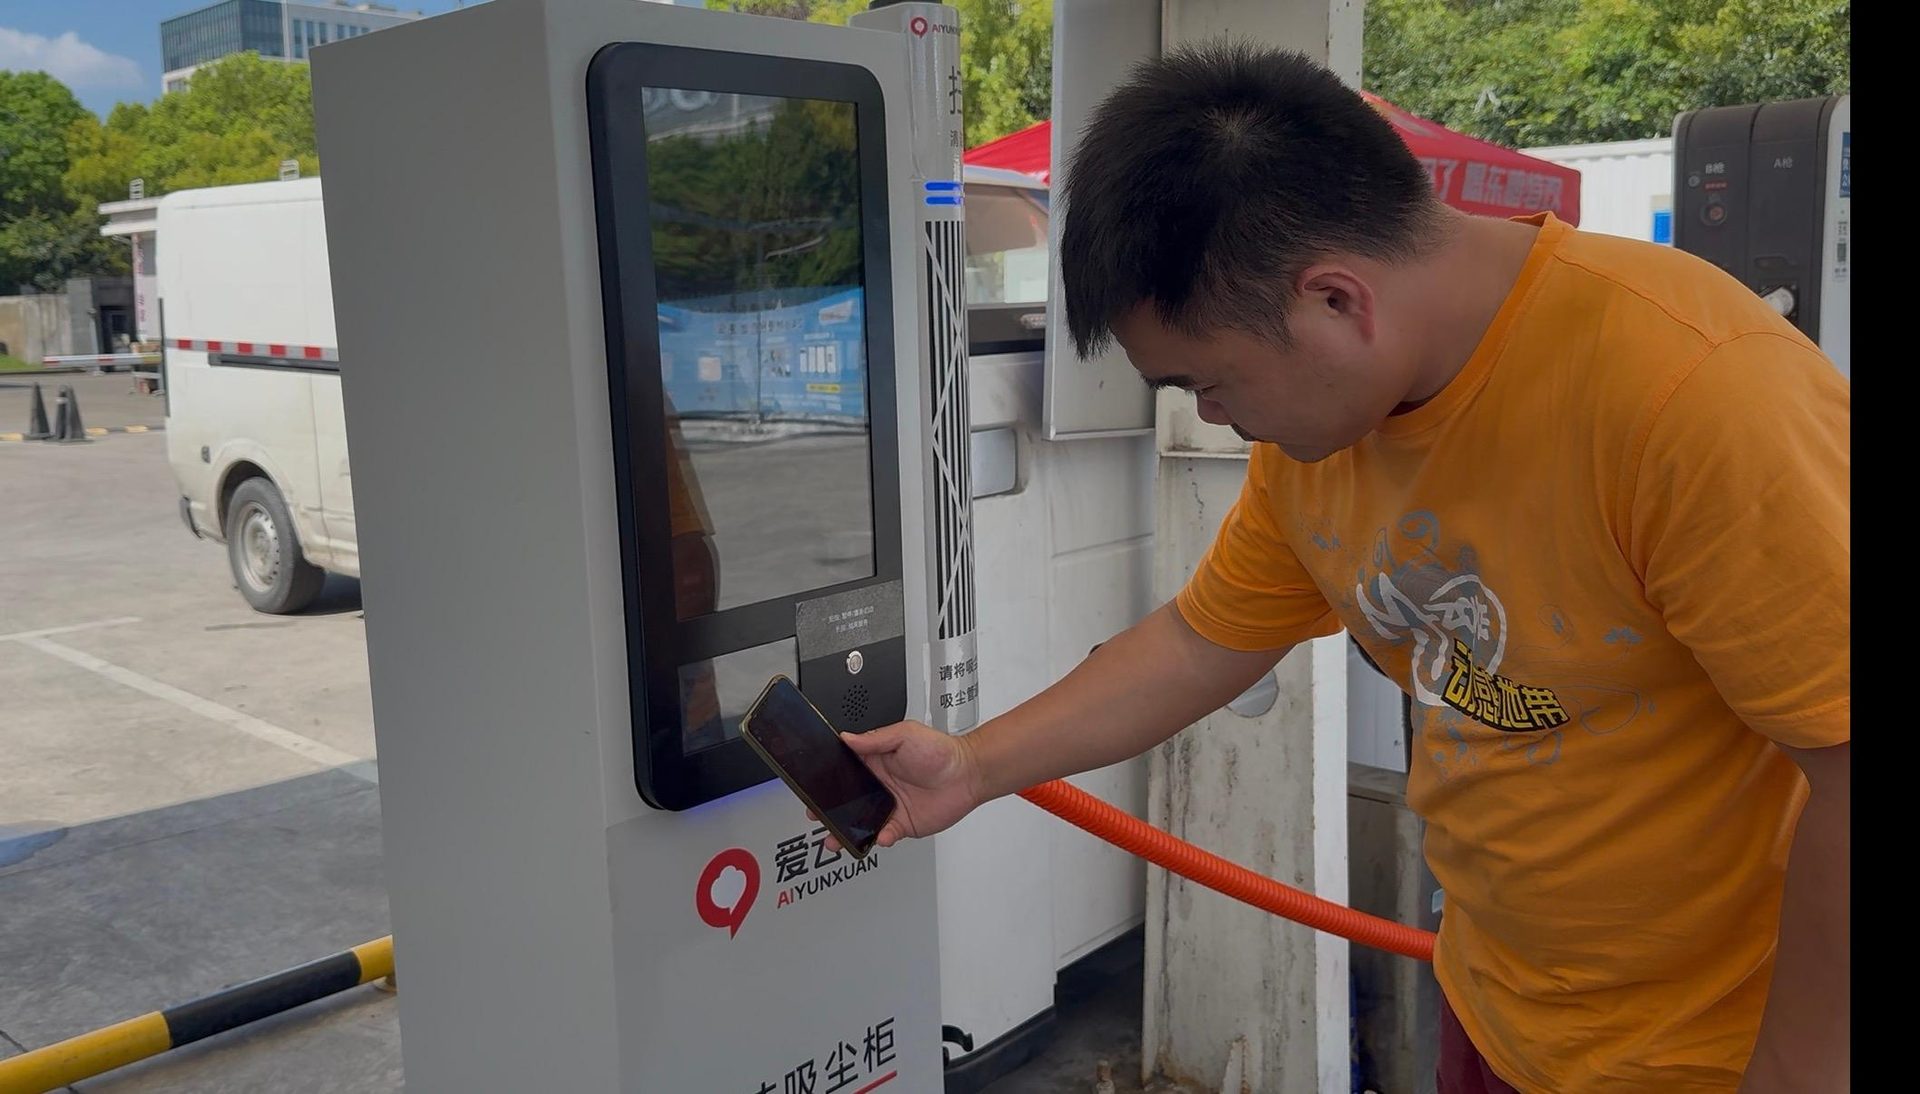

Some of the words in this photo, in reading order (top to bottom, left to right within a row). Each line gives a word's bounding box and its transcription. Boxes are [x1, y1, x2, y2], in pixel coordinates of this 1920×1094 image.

[1441, 638, 1570, 732] 动感地带
[775, 826, 842, 884] 爱云
[777, 853, 878, 909] AIYUNXUAN
